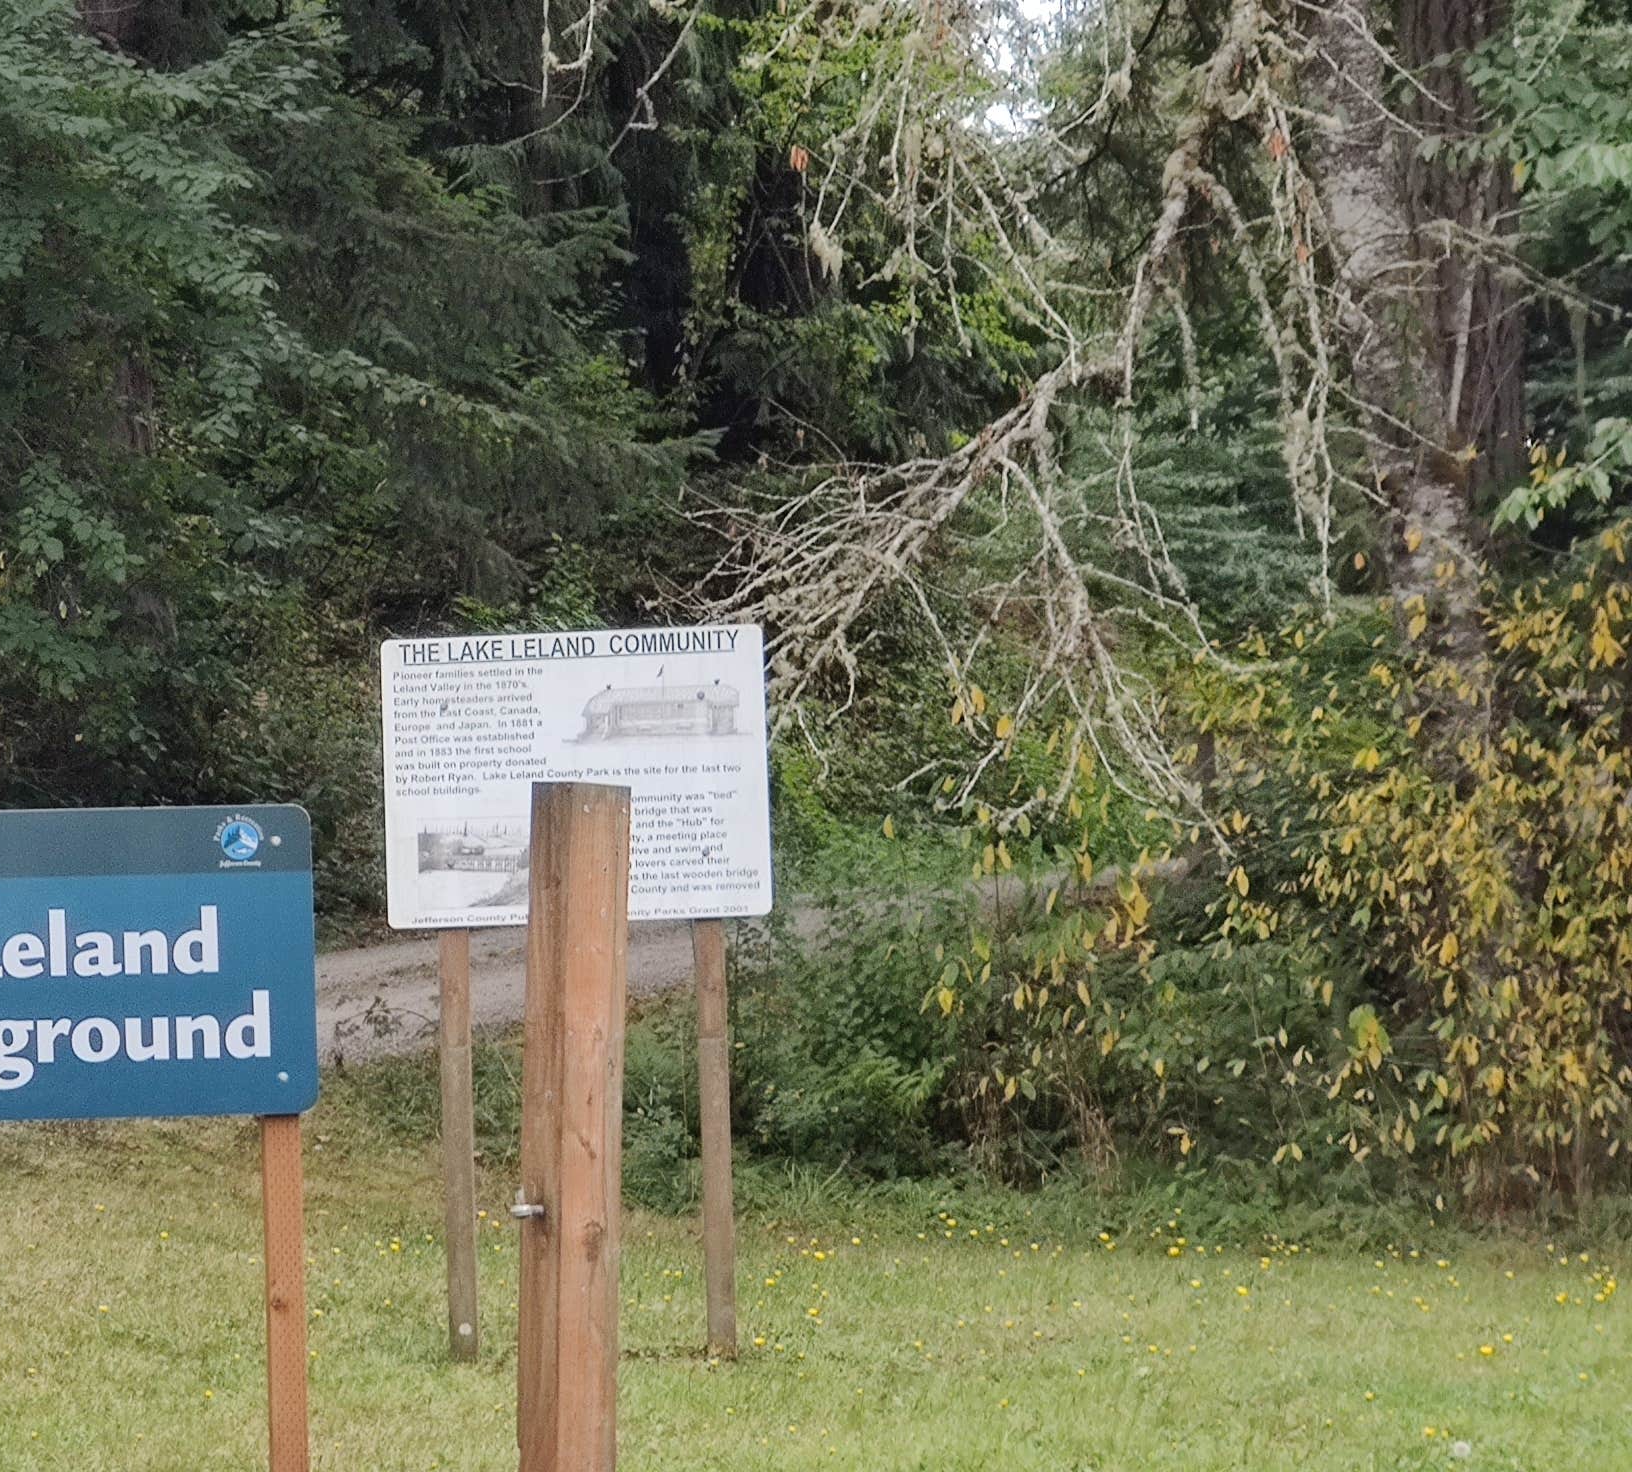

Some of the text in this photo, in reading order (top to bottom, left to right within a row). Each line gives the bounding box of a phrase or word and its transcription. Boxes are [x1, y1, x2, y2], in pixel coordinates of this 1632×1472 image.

[399, 630, 739, 664] THE LAKE LELAND COMMUNITY
[393, 667, 543, 680] Pioneer families settled in the
[393, 684, 427, 693] Leland
[430, 683, 460, 694] Valley
[476, 682, 491, 690] the
[394, 693, 532, 708] Early homesteaders arrived
[394, 711, 417, 719] from
[420, 709, 436, 717] the
[465, 708, 496, 716] Coast,
[500, 706, 541, 715] Canada,
[394, 723, 430, 733] Europe
[436, 722, 455, 730] and
[458, 721, 491, 731] Japan.
[498, 720, 507, 728] In
[395, 736, 417, 744] Post
[420, 735, 450, 743] Office
[476, 732, 534, 741] established
[417, 748, 426, 756] in
[456, 747, 471, 755] the
[474, 746, 494, 754] first
[498, 744, 531, 753] school
[418, 761, 440, 769] built
[460, 760, 502, 770] property
[506, 758, 546, 767] donated
[396, 775, 407, 784] by
[411, 774, 445, 782] Robert
[482, 772, 507, 780] Lake
[510, 770, 544, 778] Leland
[548, 767, 583, 779] County
[587, 767, 609, 776] Park
[613, 768, 621, 776] is
[625, 767, 640, 775] the
[644, 766, 661, 775] site
[665, 765, 678, 774] for
[682, 764, 697, 773] the
[702, 764, 720, 773] last
[723, 764, 741, 772] two
[396, 787, 429, 796] school
[631, 794, 682, 803] ommunity
[685, 792, 705, 800] was
[635, 807, 667, 816] bridge
[670, 806, 689, 814] that
[636, 817, 724, 828] and the "Hub" for
[647, 833, 653, 841] a
[656, 832, 697, 841] meeting
[700, 830, 727, 839] place
[652, 845, 671, 854] and
[675, 844, 700, 853] swim
[635, 859, 666, 868] lovers
[670, 857, 704, 866] carved
[707, 856, 730, 864] their
[642, 872, 658, 880] the
[661, 870, 679, 879] last
[682, 870, 723, 878] wooden
[726, 868, 759, 877] bridge
[631, 884, 667, 895] County
[670, 883, 689, 892] and
[716, 882, 760, 890] removed
[654, 907, 685, 915] Parks
[689, 906, 719, 914] Grant
[412, 915, 463, 924] Jefferson
[467, 914, 506, 923] County
